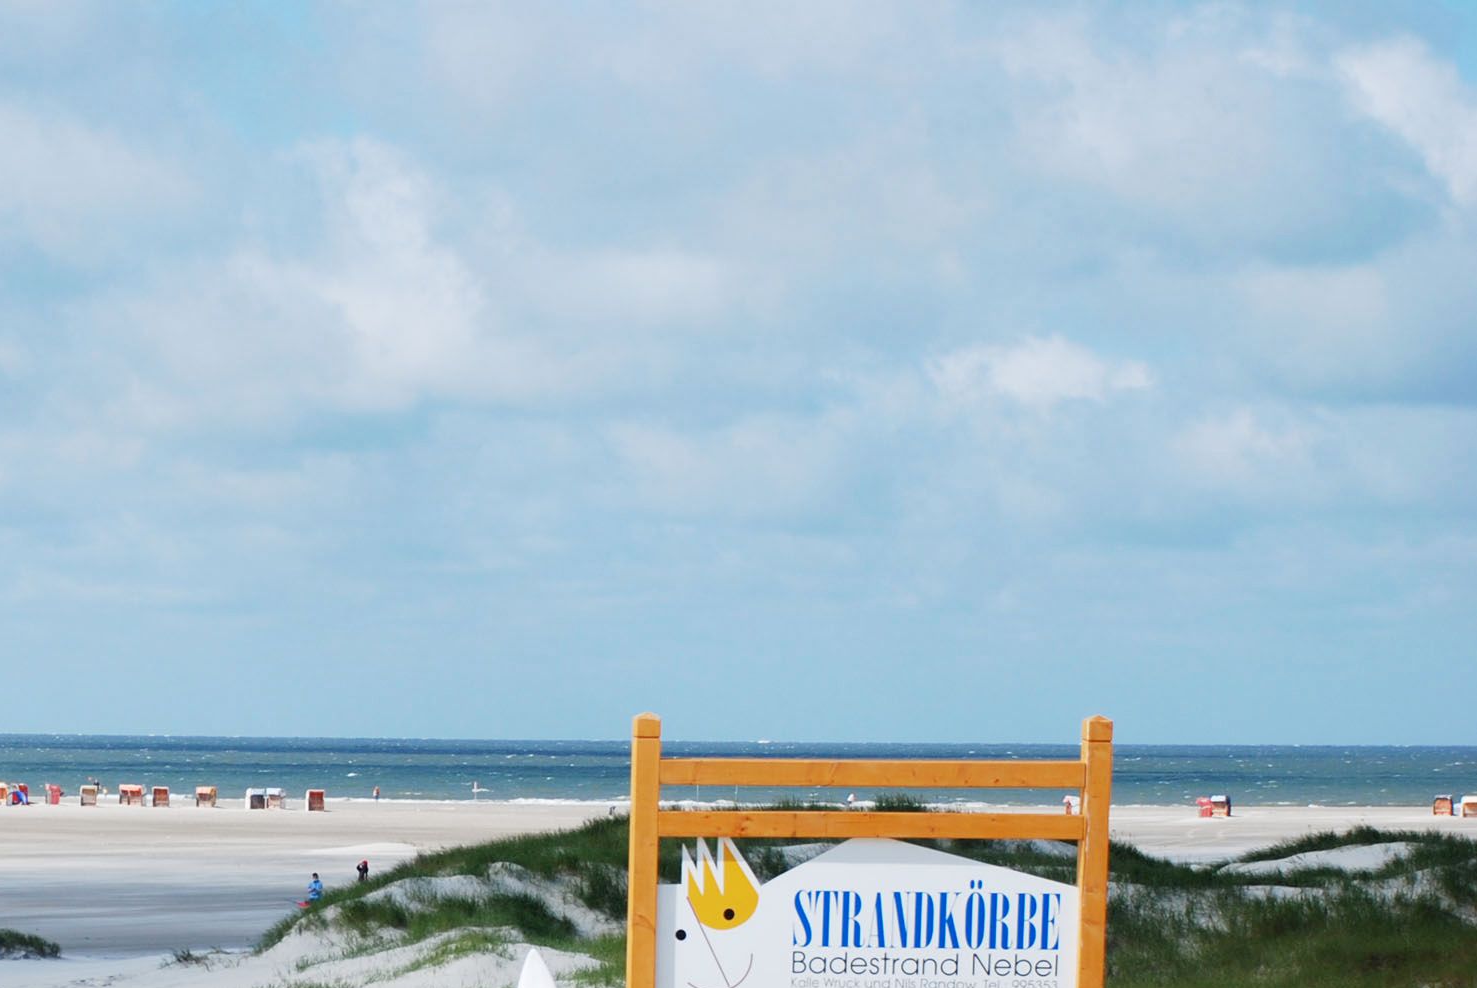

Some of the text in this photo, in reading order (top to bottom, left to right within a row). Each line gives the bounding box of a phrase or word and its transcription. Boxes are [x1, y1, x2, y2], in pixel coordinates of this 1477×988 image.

[792, 880, 1061, 951] STRANDKÖRBE
[791, 951, 1059, 977] Badestrand Nebel
[791, 978, 819, 988] Kalle
[823, 978, 860, 988] Wruck
